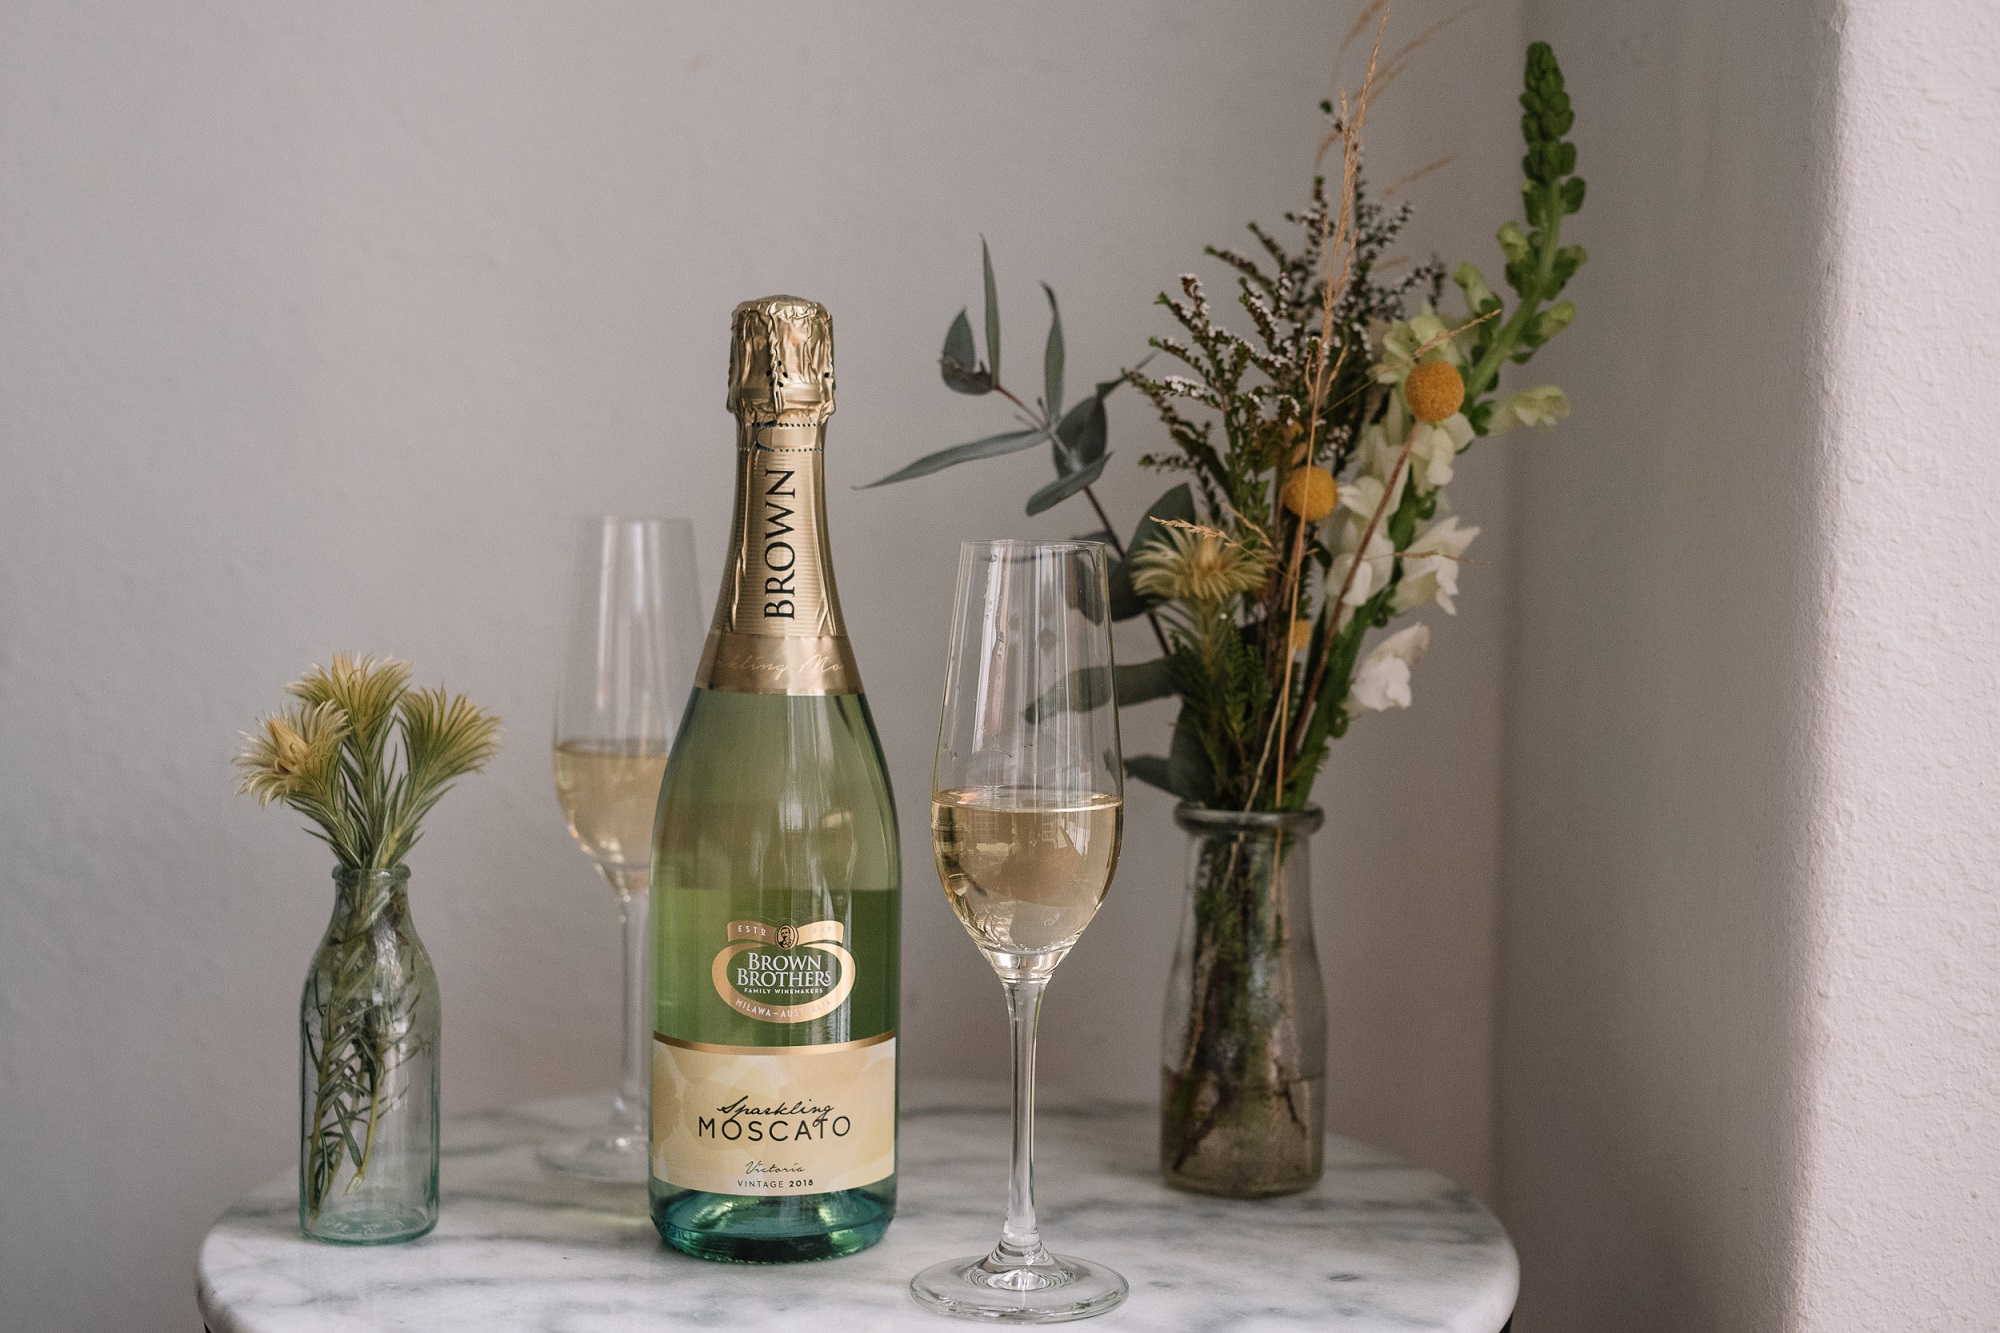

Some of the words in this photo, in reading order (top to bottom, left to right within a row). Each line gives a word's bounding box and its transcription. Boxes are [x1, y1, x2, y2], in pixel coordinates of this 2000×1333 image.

[764, 468, 796, 620] BROWN
[747, 952, 822, 971] BROWN
[736, 968, 832, 987] BROTHERS
[716, 1095, 834, 1127] Sparkling
[698, 1116, 851, 1142] MOSCATO
[745, 1161, 805, 1174] Victoria
[737, 1180, 784, 1188] VINTAGE
[788, 1179, 814, 1188] 2018
